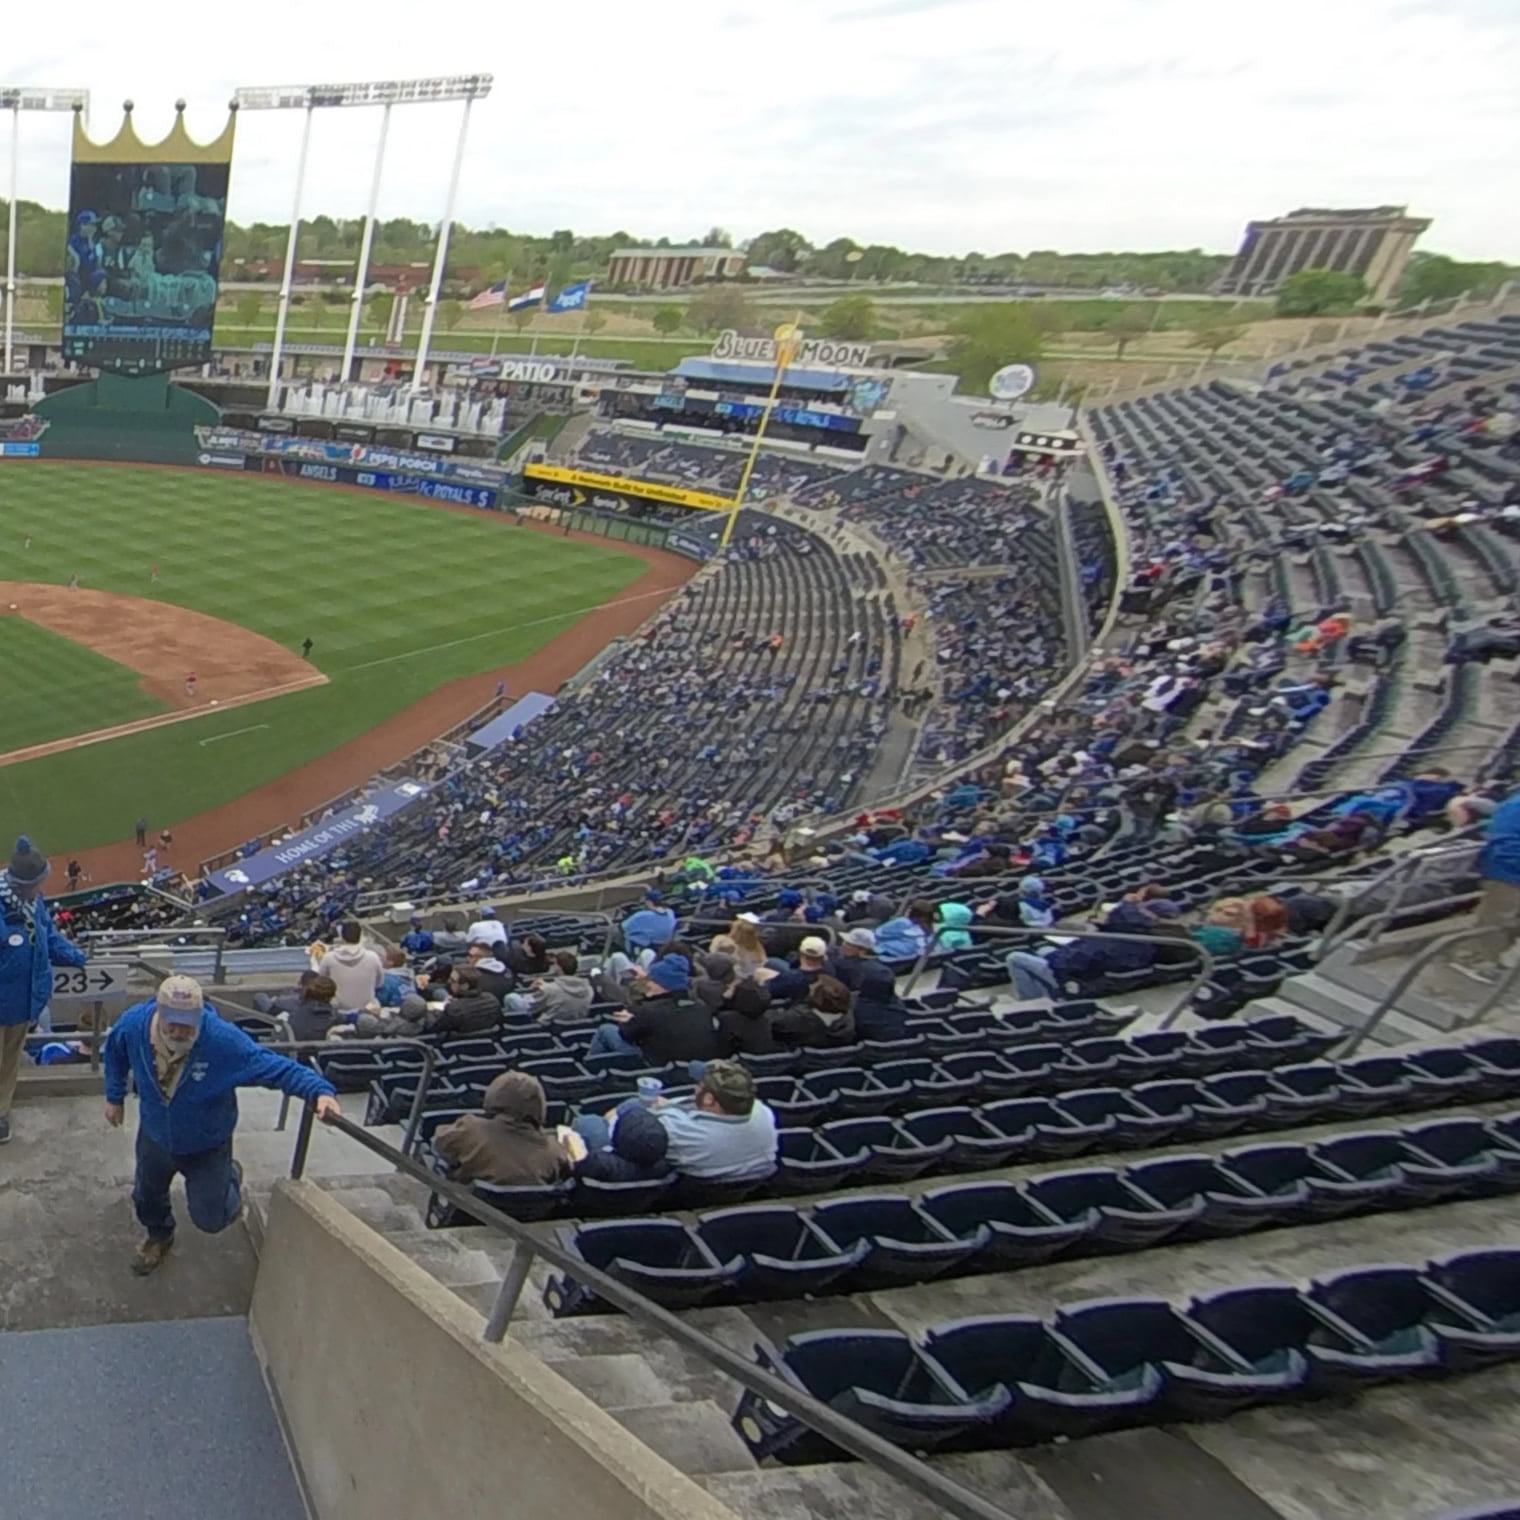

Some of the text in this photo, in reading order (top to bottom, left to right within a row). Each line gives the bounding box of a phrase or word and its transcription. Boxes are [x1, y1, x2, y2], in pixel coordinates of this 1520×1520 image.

[717, 332, 866, 364] BLUE MOON
[500, 361, 555, 381] PATIO
[369, 452, 437, 472] PEPSI PORCH
[299, 463, 337, 481] ANGELS
[433, 484, 472, 504] ROYALS
[275, 819, 358, 864] HOME OF THE
[54, 972, 87, 995] 23
